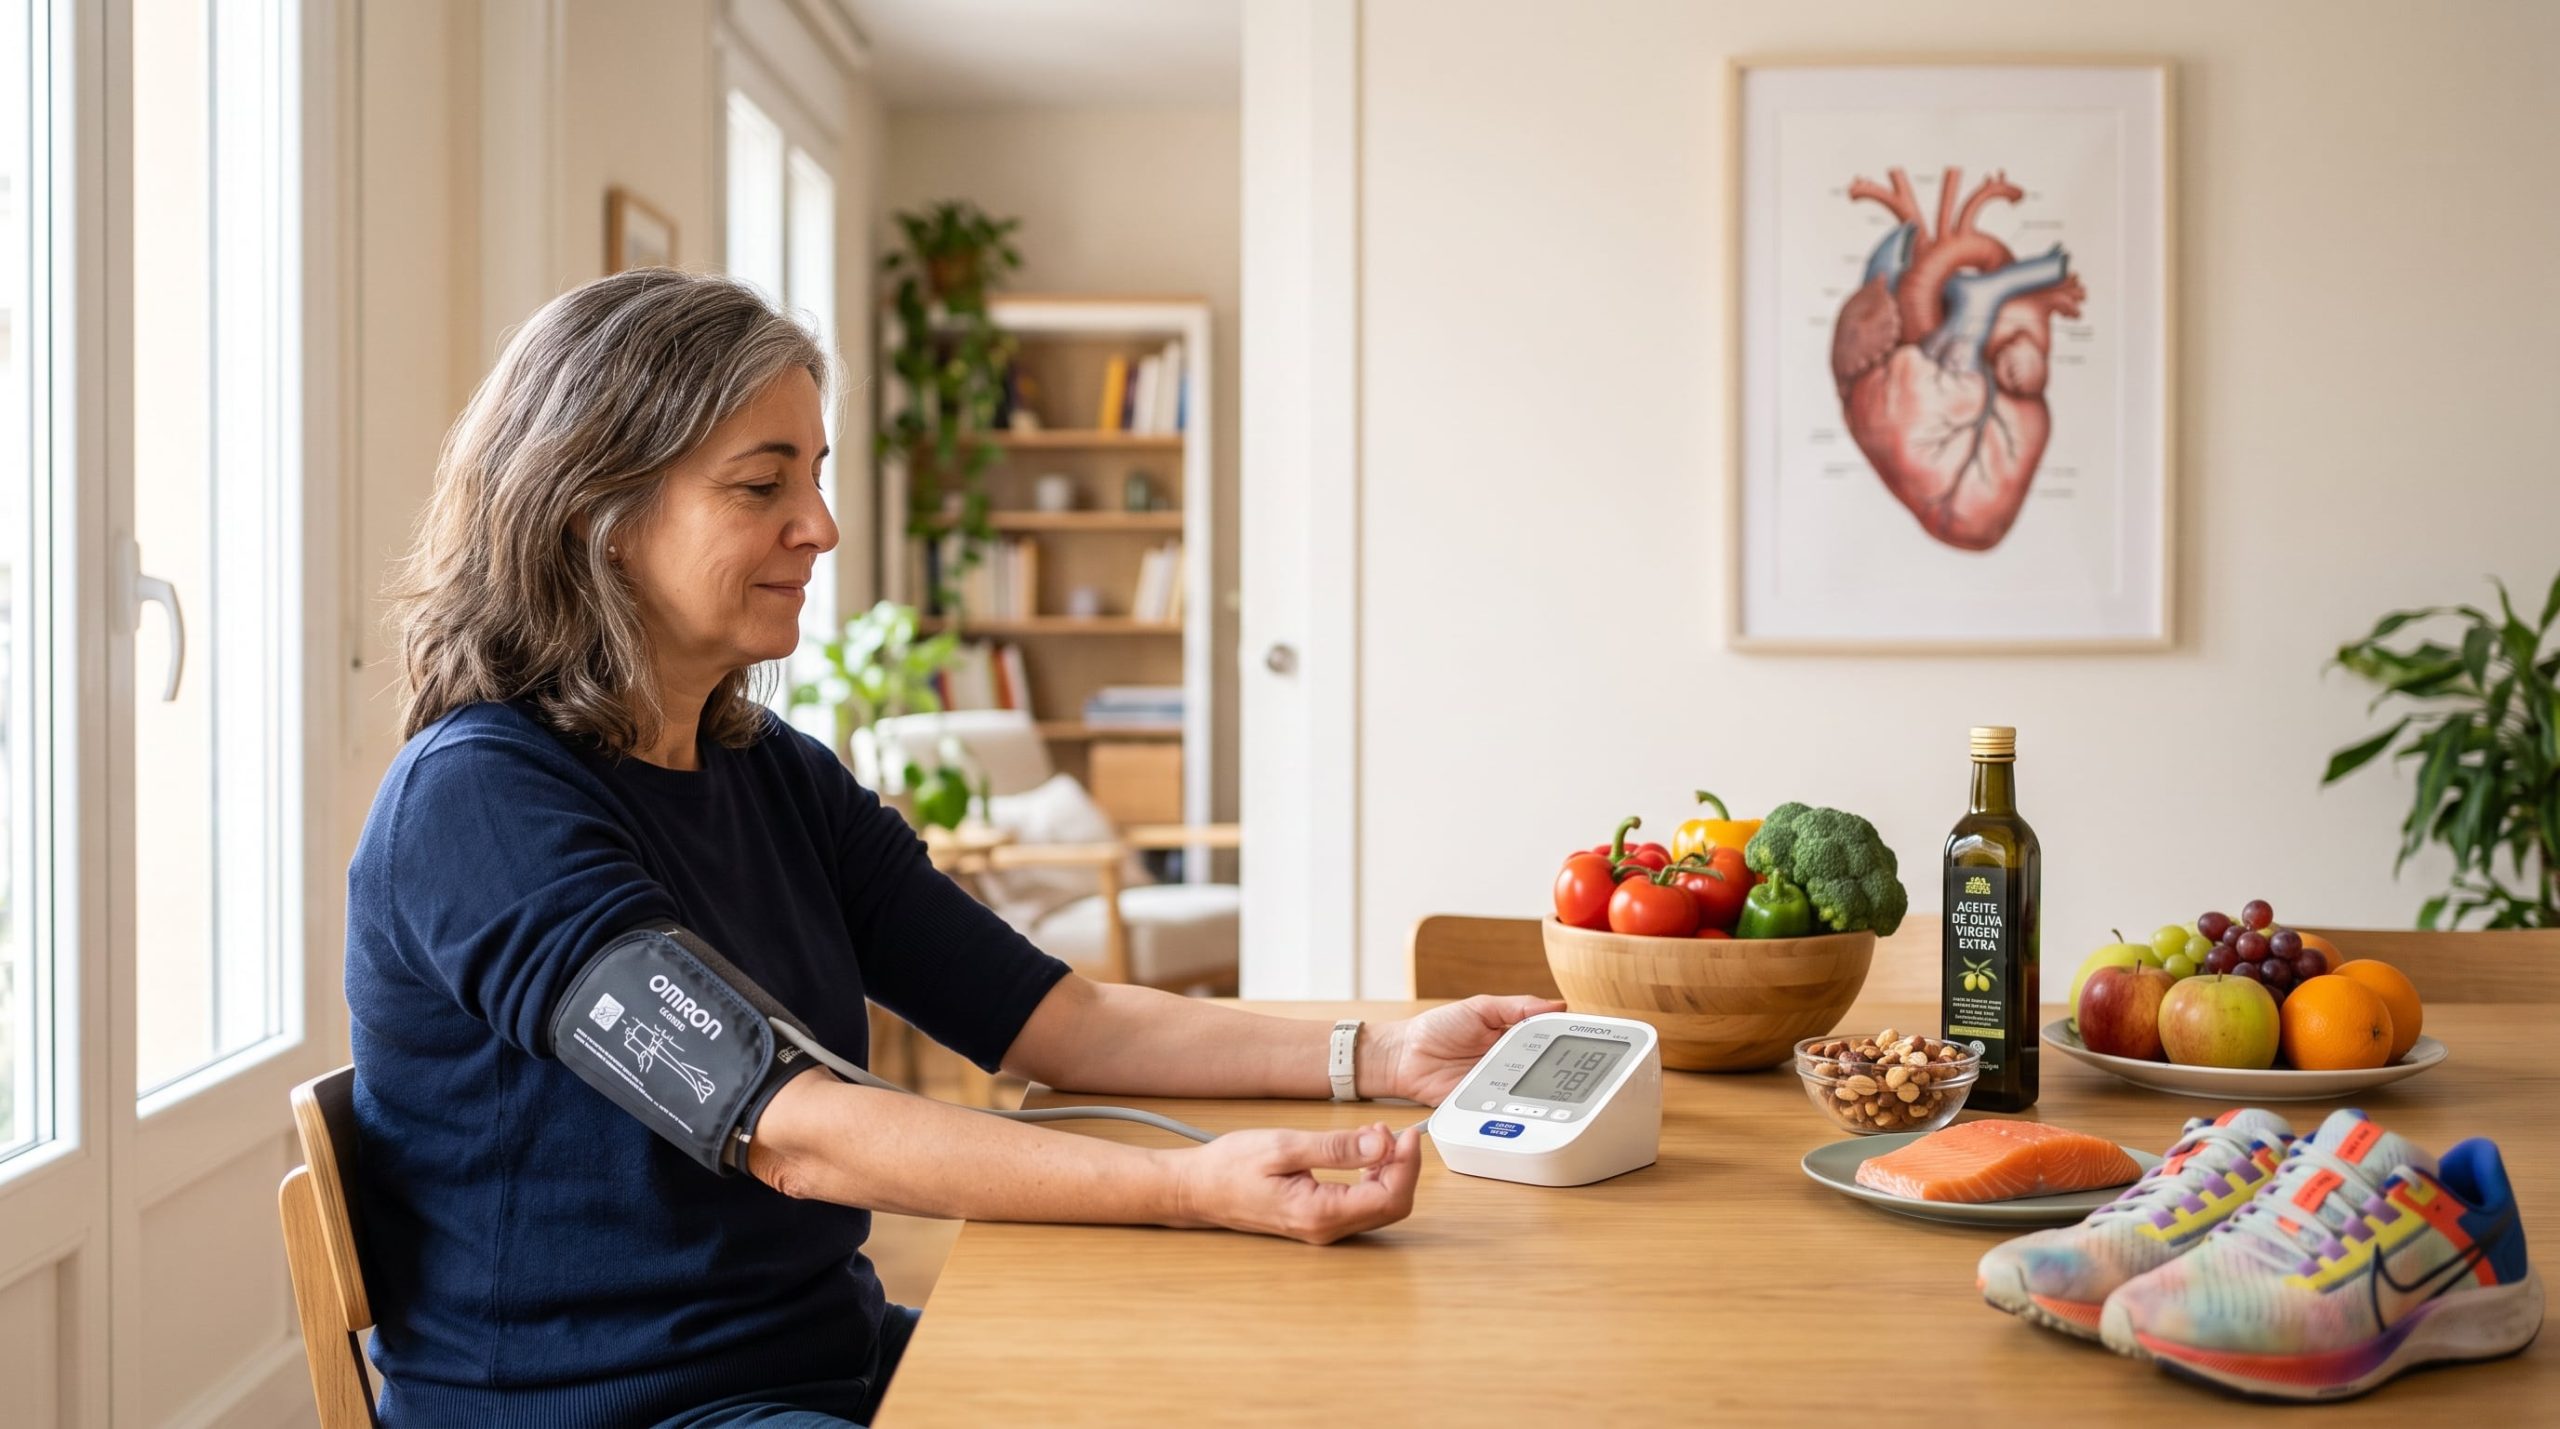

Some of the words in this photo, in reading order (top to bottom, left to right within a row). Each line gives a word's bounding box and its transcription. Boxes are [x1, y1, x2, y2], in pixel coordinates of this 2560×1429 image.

[1952, 913, 1968, 924] DE
[1970, 914, 2003, 927] OLIVA
[1955, 925, 1999, 939] VIRGEN
[1959, 938, 1997, 951] EXTRA
[649, 974, 723, 1041] OMRON
[1569, 1025, 1612, 1036] OMRON
[1555, 1050, 1608, 1072] 118
[1552, 1070, 1590, 1091] 78
